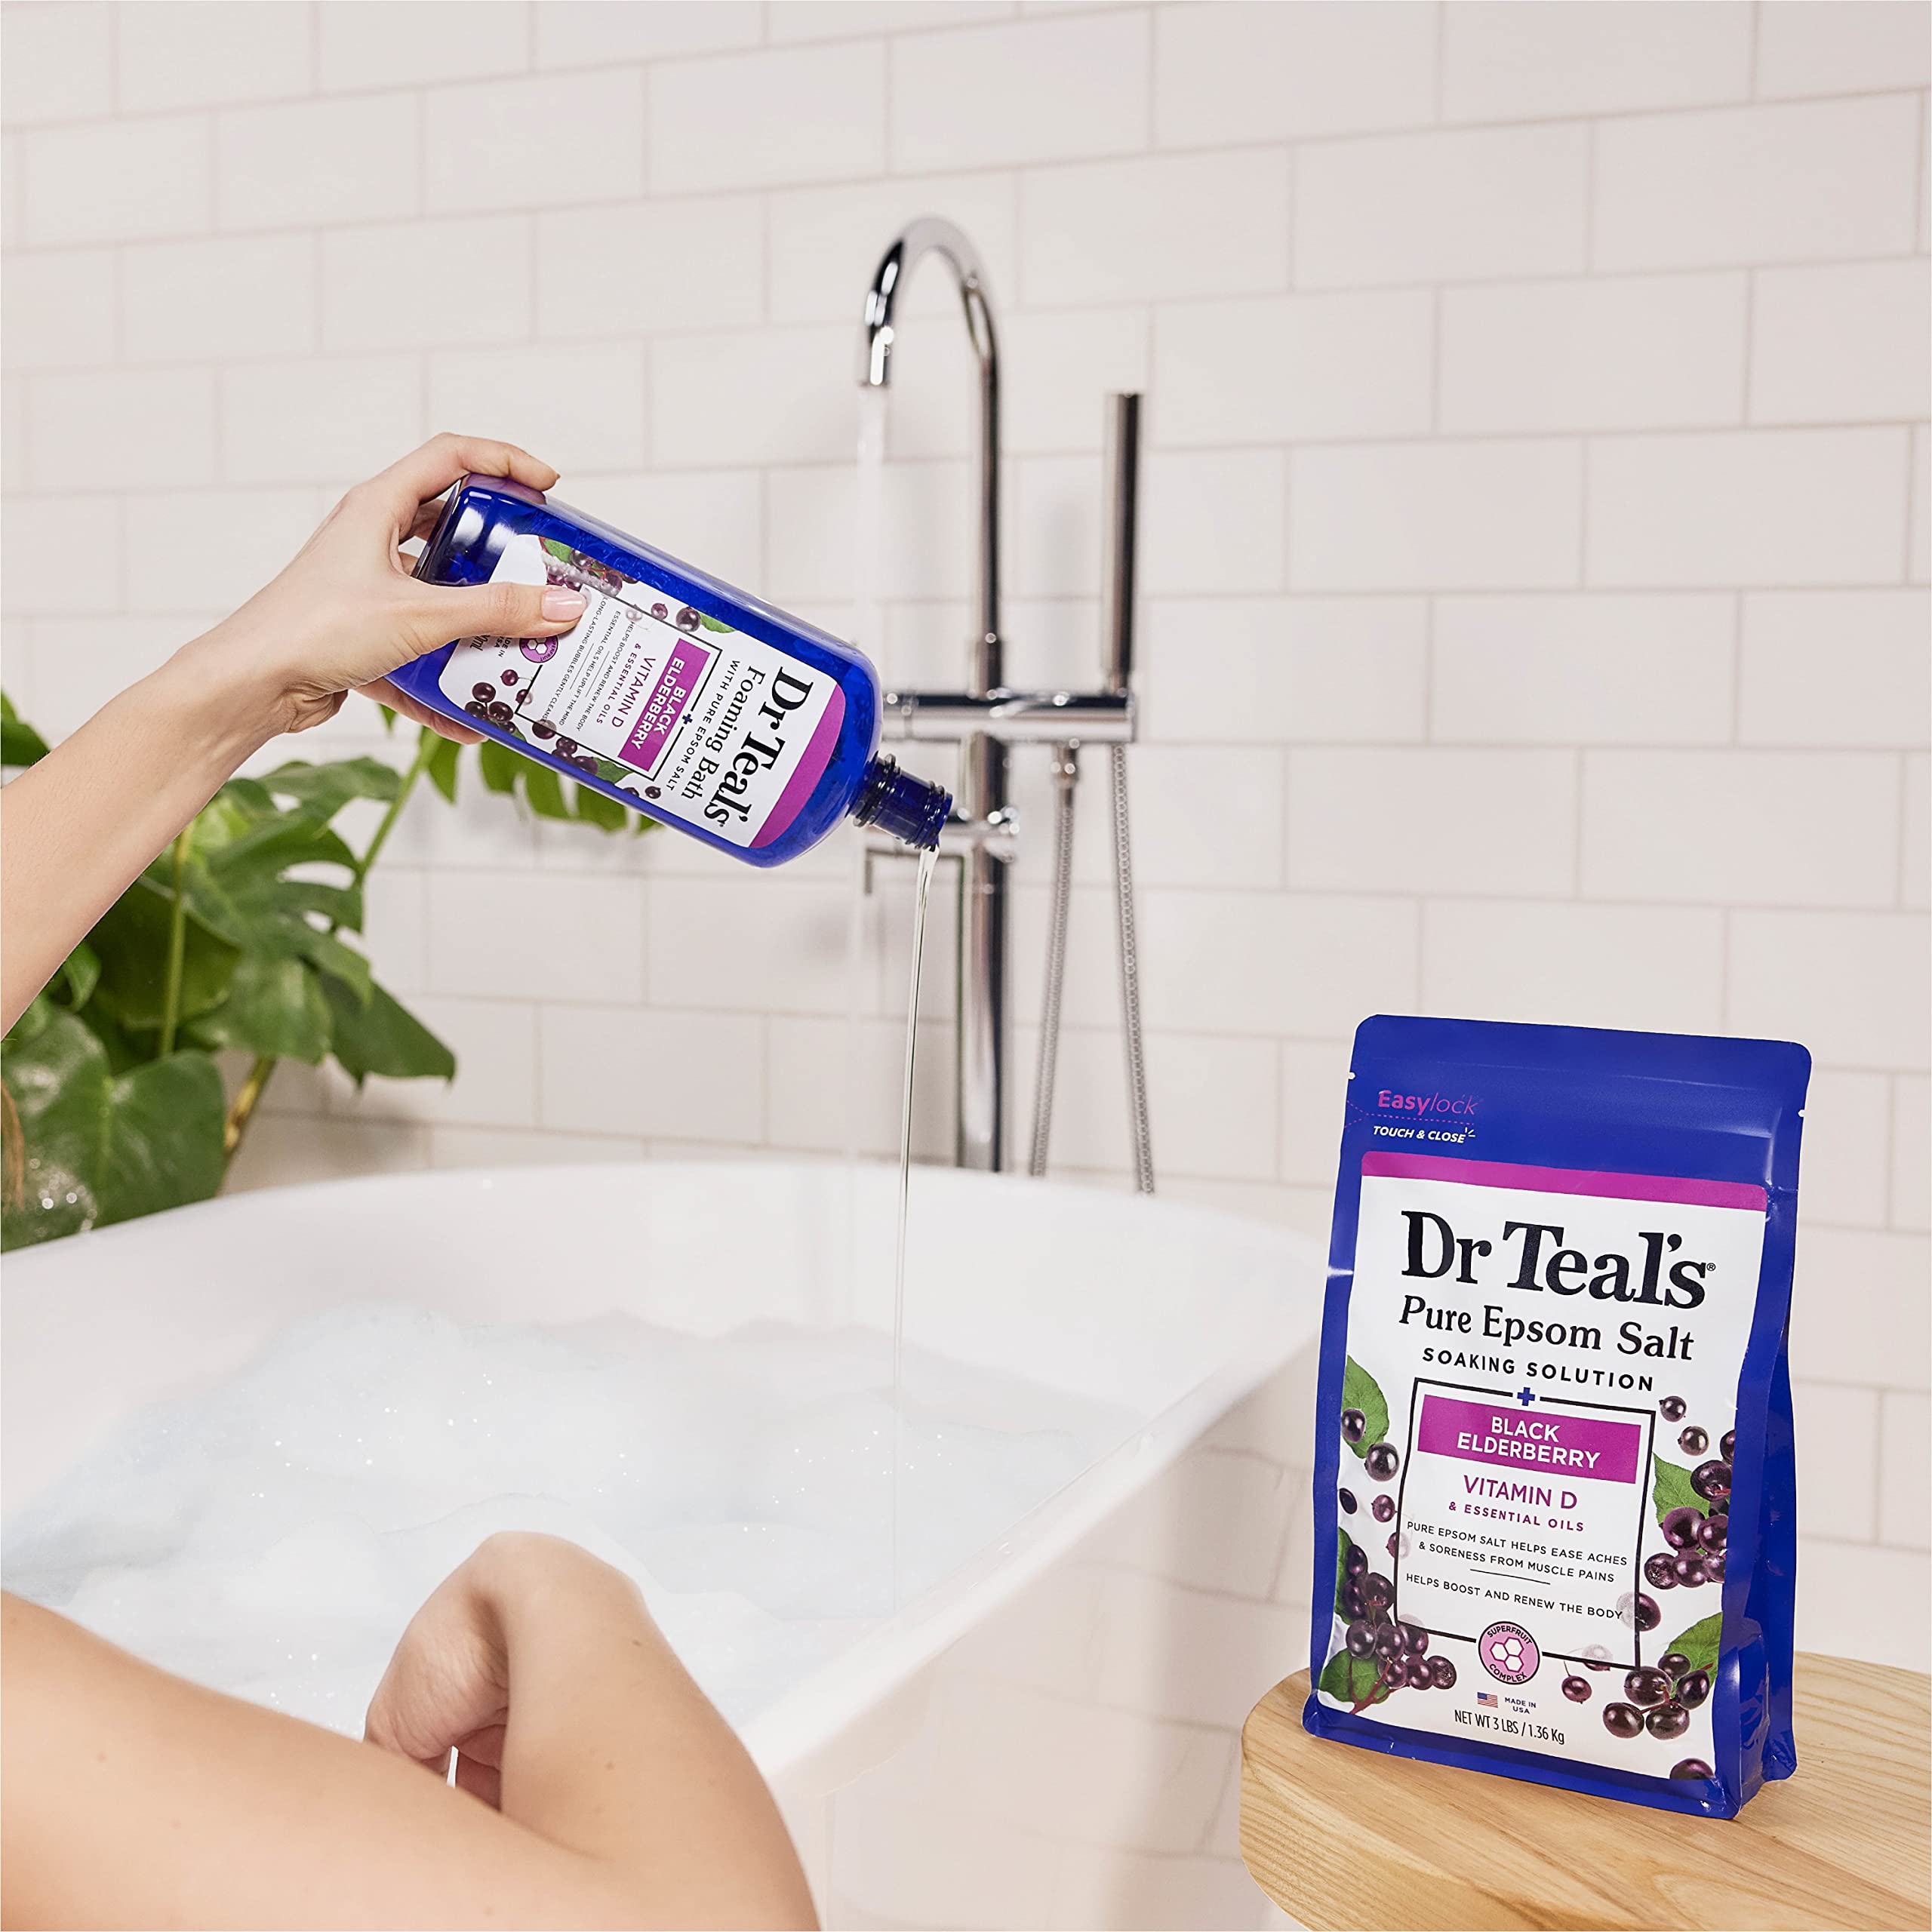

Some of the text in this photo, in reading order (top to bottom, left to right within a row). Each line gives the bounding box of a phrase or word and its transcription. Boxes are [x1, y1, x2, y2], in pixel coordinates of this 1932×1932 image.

[498, 649, 506, 658] IN
[539, 596, 608, 723] LONG-LASTING BUBBLES GENTLY CLEANSE
[540, 638, 556, 662] UPERFRUIT
[558, 611, 620, 725] ESSENTIAL OILS HELP UPLIFT THE MIND
[576, 620, 635, 731] HELPS BOOST AND RENEW THE BODY
[608, 652, 637, 700] ESSENTIAL
[611, 657, 656, 727] VITAMIN D
[596, 703, 610, 723] OILS
[631, 657, 685, 749] ELDERBERRY
[653, 685, 686, 734] BLACK
[758, 666, 814, 730] Dr
[666, 660, 740, 790] WITH PURE EPSOM SALT
[681, 666, 765, 798] Foaming Bath
[1378, 1090, 1478, 1115] Easylock
[1373, 1125, 1466, 1143] TOUCH & CLOSE
[1401, 1210, 1492, 1284] Dr
[1398, 1294, 1694, 1361] Pure Epsom Salt
[1422, 1347, 1653, 1392] SOAKING SOLUTION
[1457, 1432, 1601, 1469] ELDERBERRY
[1491, 1416, 1560, 1443] BLACK
[1463, 1475, 1577, 1509] VITAMIN D
[1448, 1502, 1584, 1532] & ESSENTIAL OILS
[1407, 1521, 1628, 1566] PURE EPSOM SALT HELPS EASE ACHES
[1419, 1542, 1615, 1583] & SORENESS FROM MUSCLE PAINS
[1406, 1573, 1623, 1620] HELPS BOOST AND RENEW THE BODY
[1487, 1626, 1533, 1644] SUPERFRUIT
[1490, 1663, 1527, 1682] COMPLEX
[1505, 1697, 1527, 1707] MADE
[1512, 1706, 1531, 1715] USA
[1454, 1709, 1565, 1745] NET WT 3 LBS / 1.36 Kg
